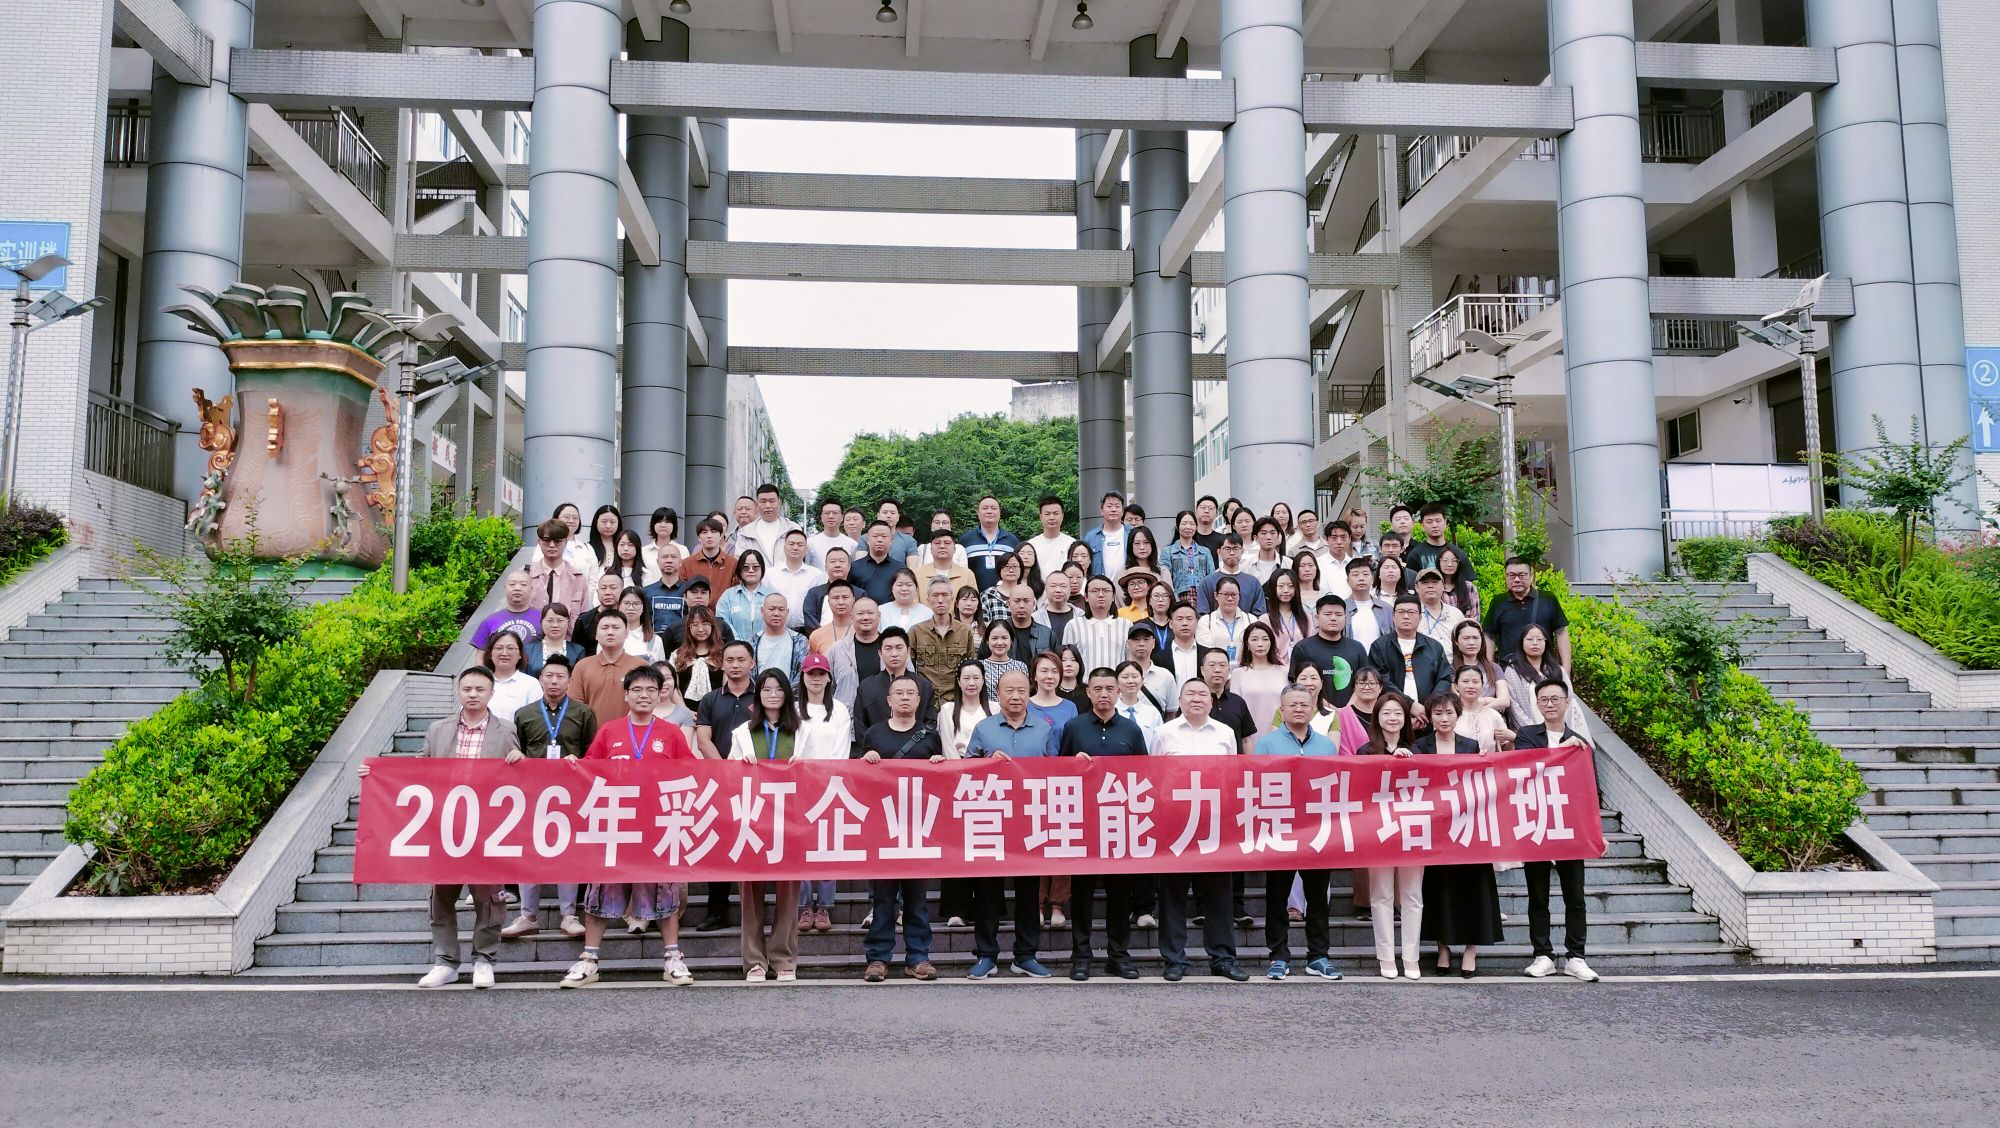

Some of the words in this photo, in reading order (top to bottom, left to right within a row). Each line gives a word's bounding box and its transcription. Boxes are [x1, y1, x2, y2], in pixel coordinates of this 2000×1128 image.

[390, 761, 1575, 867] 2026年彩灯企业管理能力提升培训班
